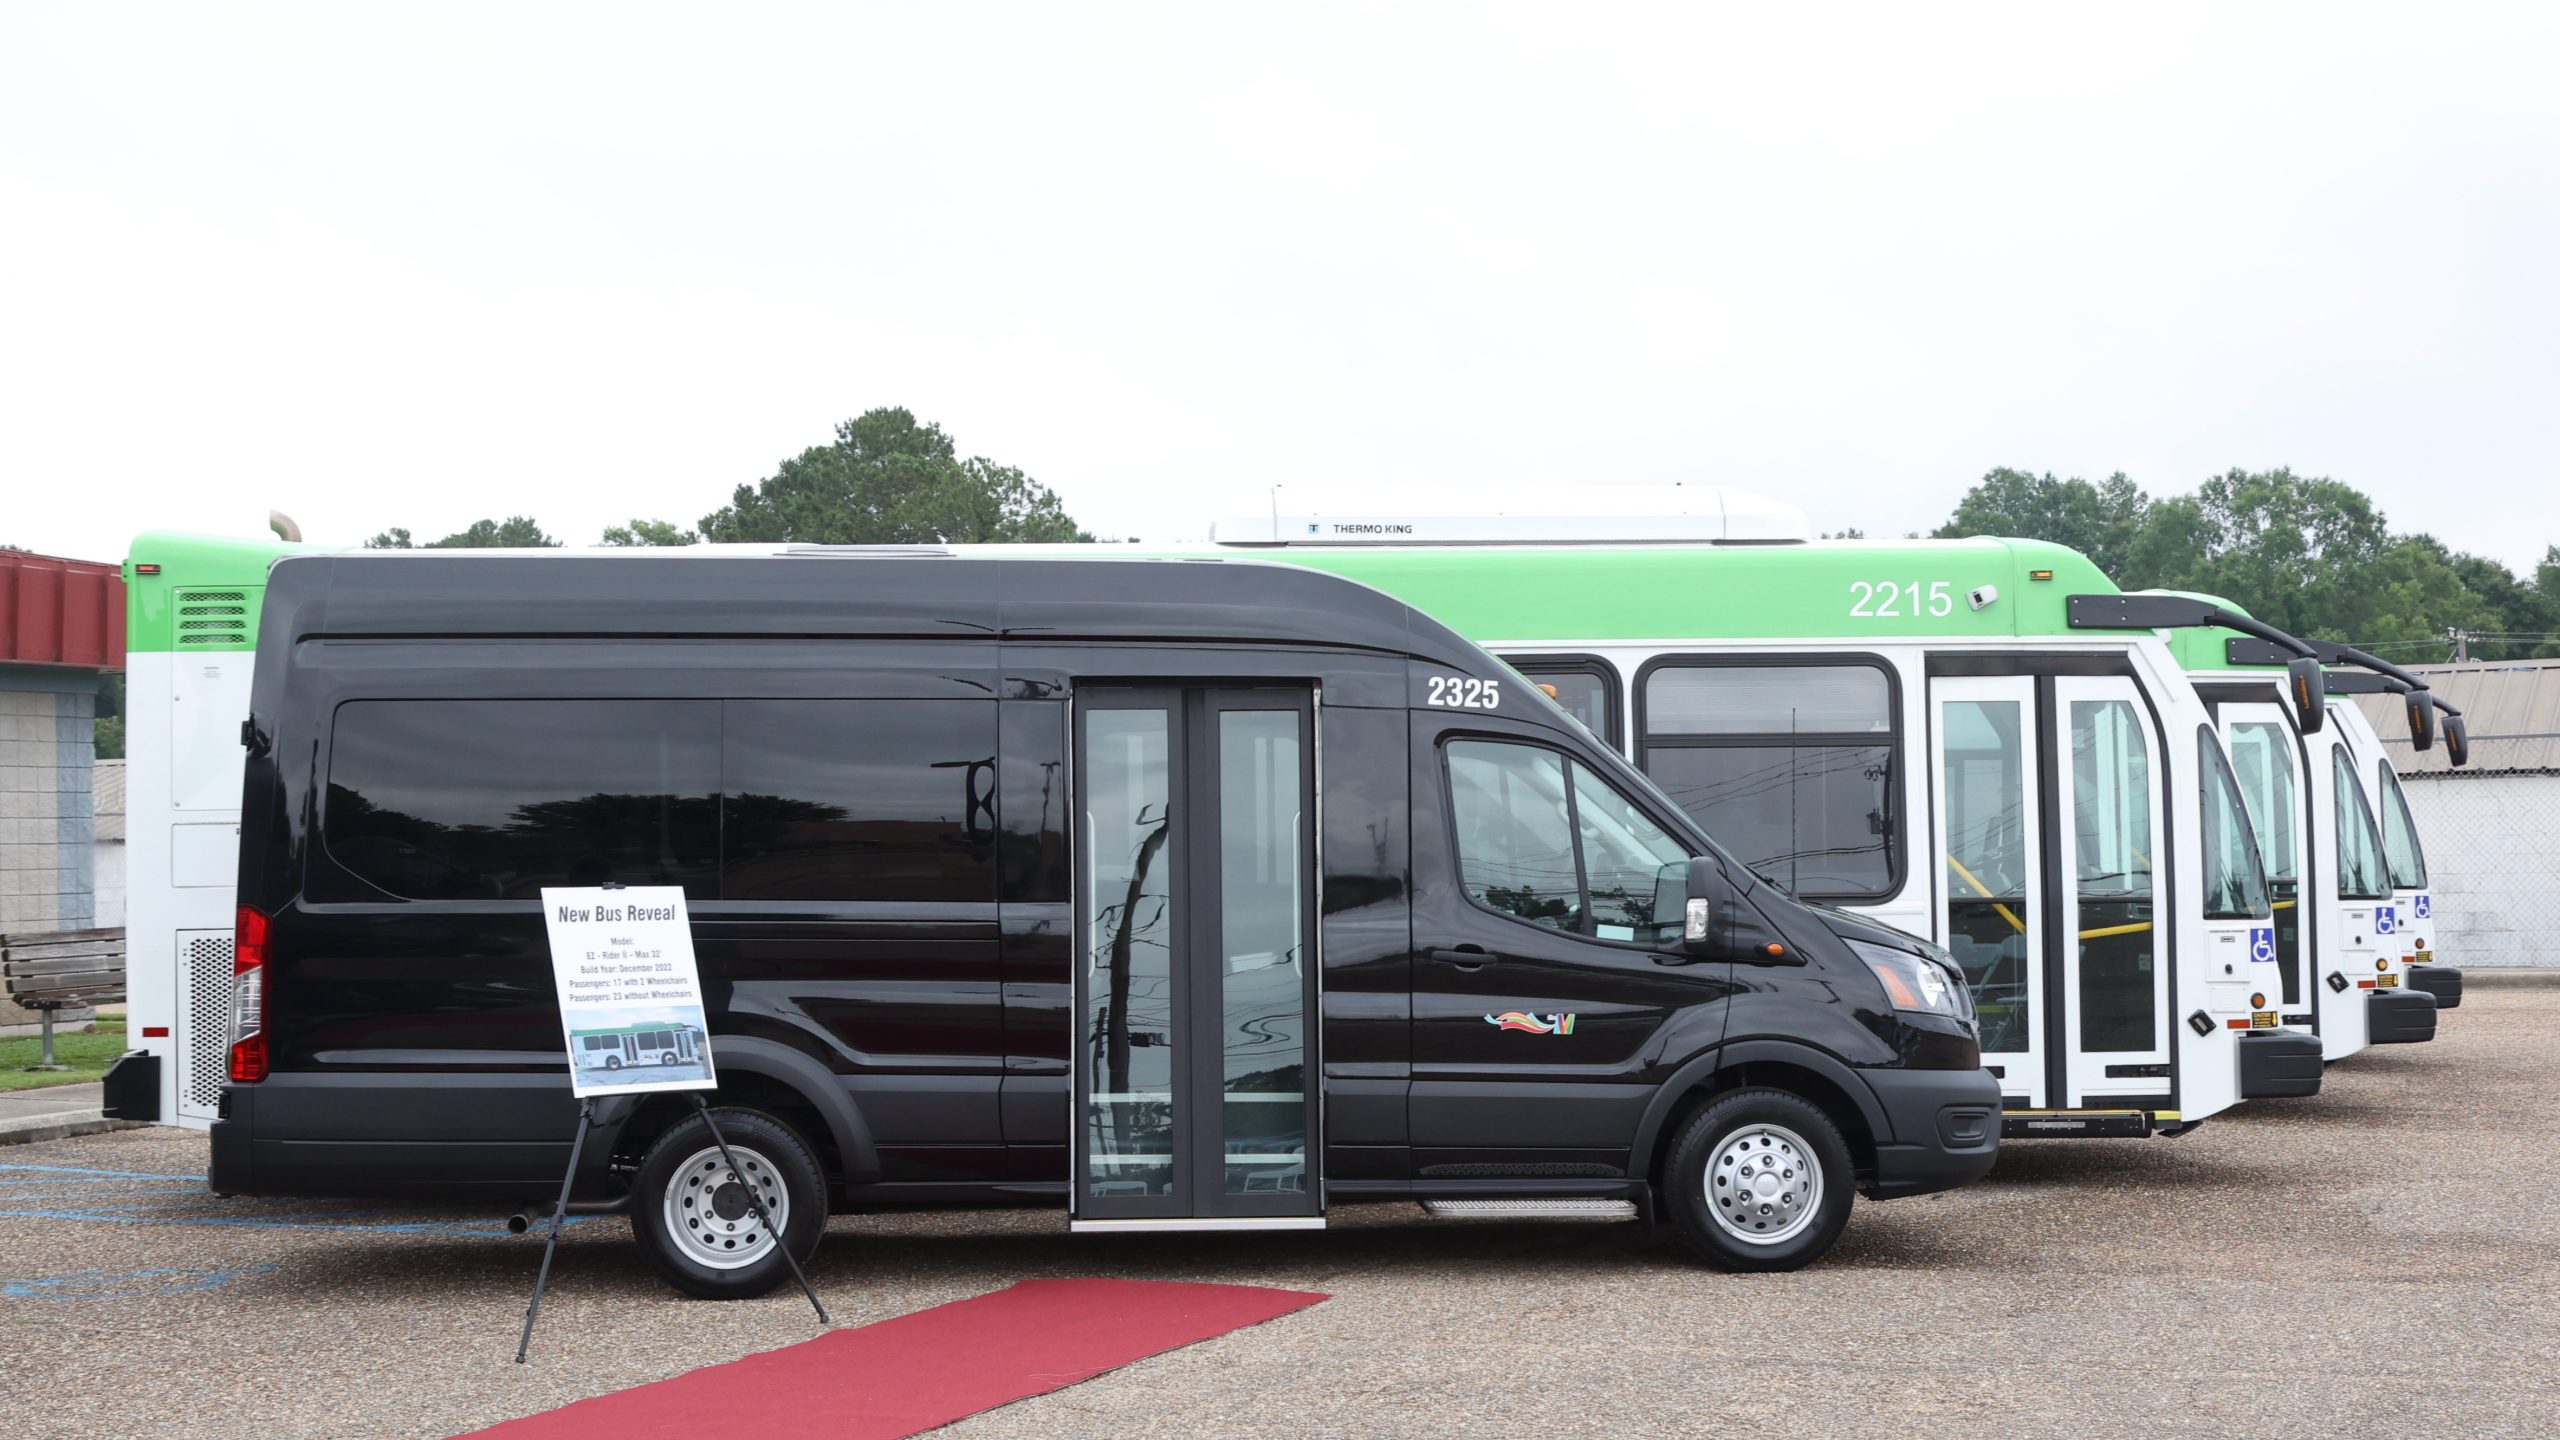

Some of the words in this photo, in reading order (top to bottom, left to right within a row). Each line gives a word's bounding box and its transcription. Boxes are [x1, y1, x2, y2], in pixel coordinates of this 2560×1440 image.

[1333, 524, 1383, 534] THERMO
[1385, 524, 1412, 534] KING
[1849, 581, 1953, 617] 2215
[1427, 676, 1500, 709] 2325
[558, 906, 590, 923] New
[595, 905, 622, 922] Bus
[627, 904, 675, 921] Reveal
[611, 937, 634, 945] Model:
[586, 951, 595, 960] EZ
[602, 950, 620, 959] Rider
[635, 949, 650, 958] Max
[580, 965, 599, 974] Build
[600, 965, 618, 973] Year:
[620, 964, 653, 973] December
[655, 963, 672, 972] 2022
[569, 979, 612, 989] Passengers:
[624, 978, 639, 986] with
[640, 977, 645, 986] 2
[647, 977, 688, 985] Wheelchairs
[569, 993, 612, 1003] Passengers:
[624, 991, 650, 1000] without
[651, 990, 693, 999] Wheelchairs
